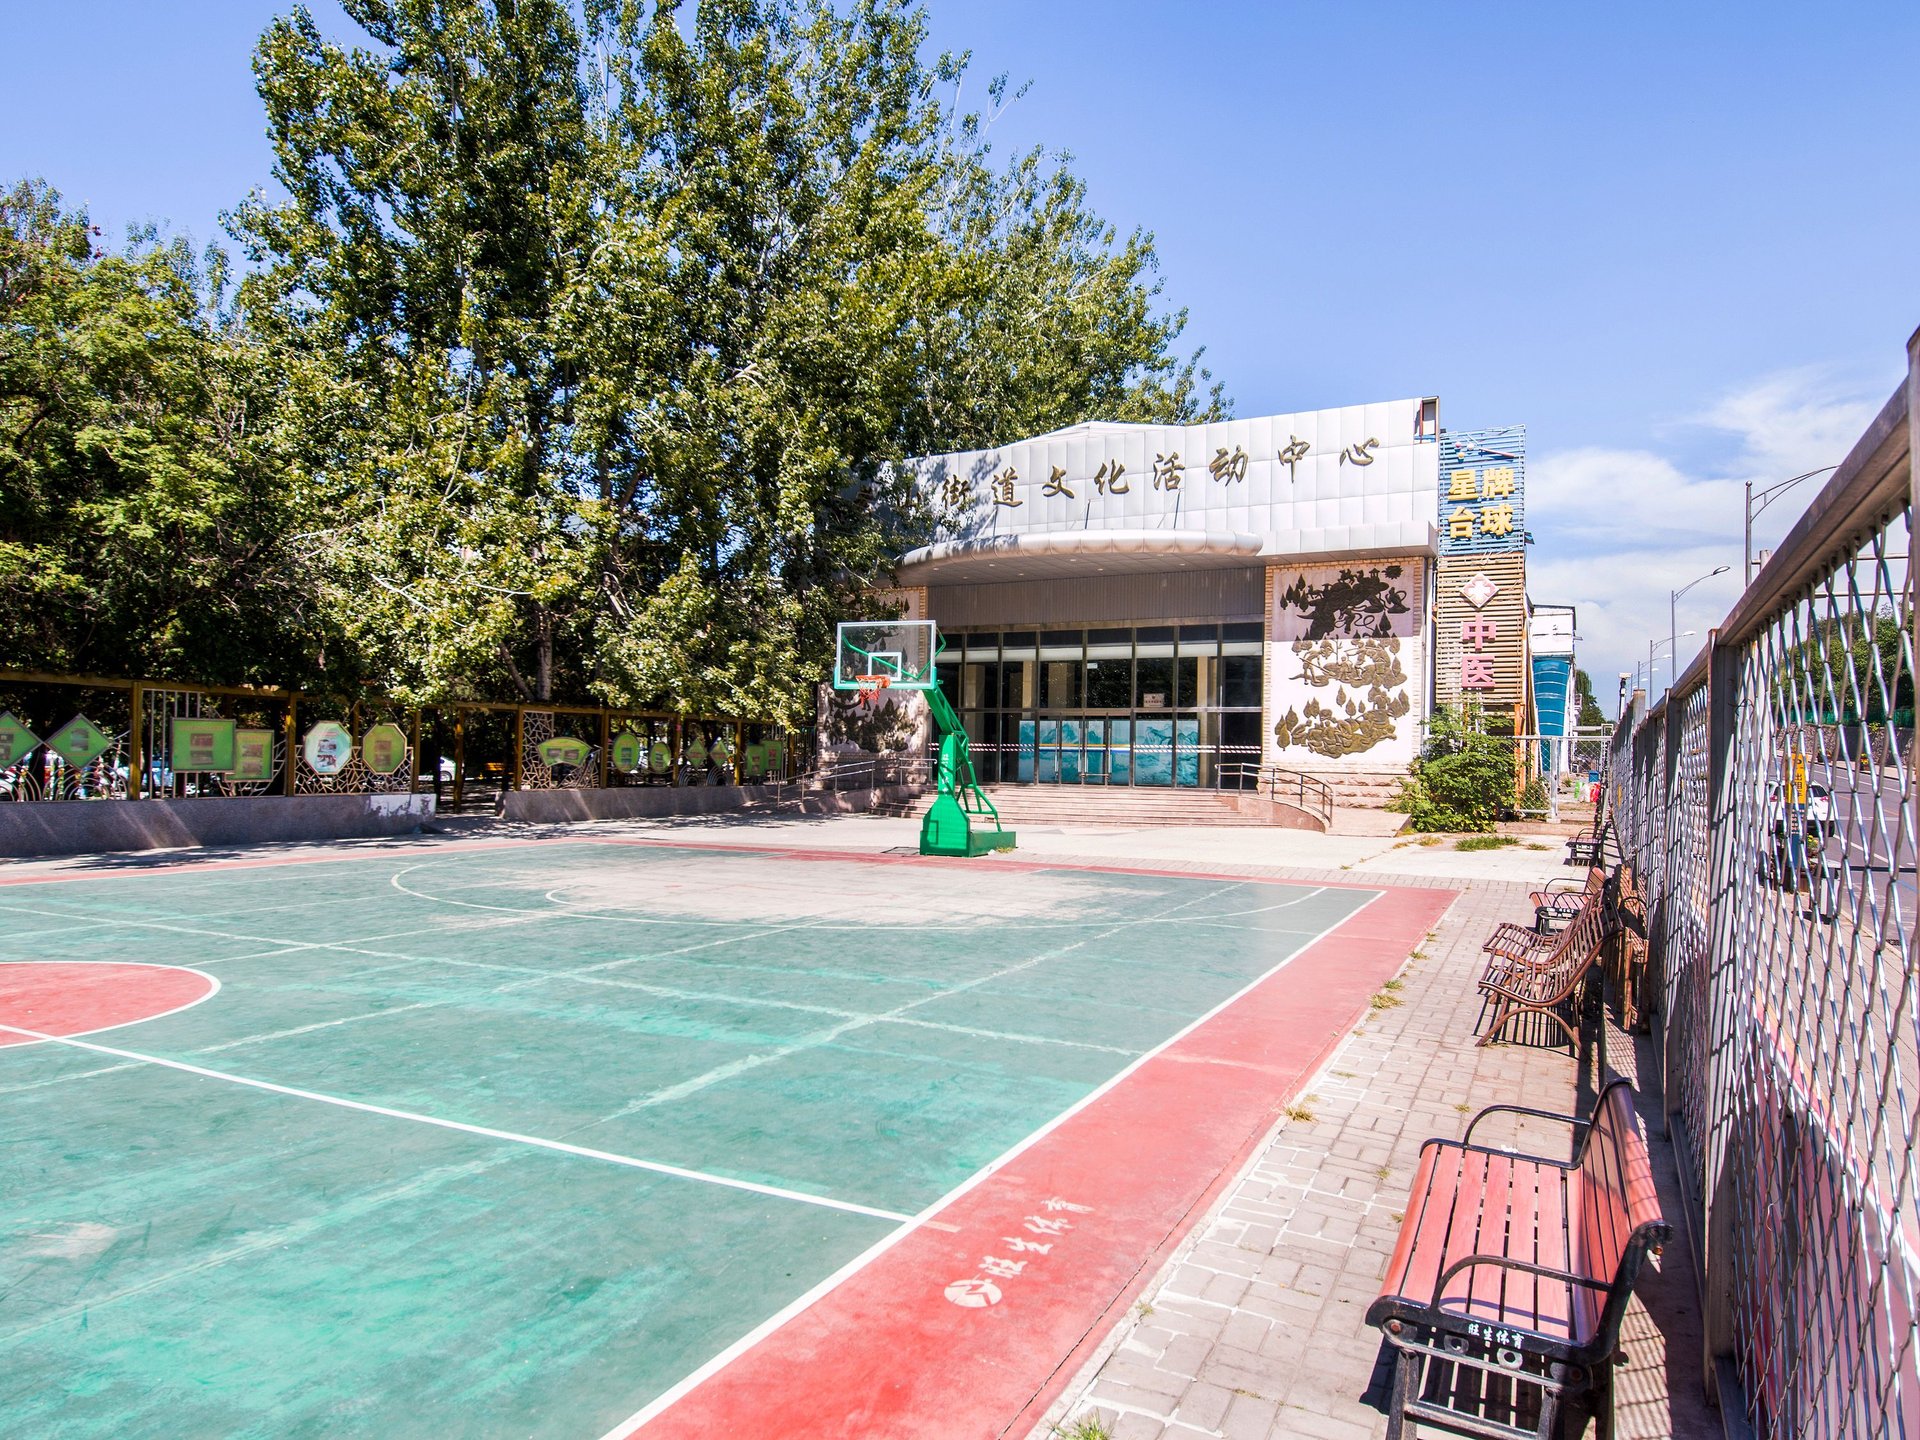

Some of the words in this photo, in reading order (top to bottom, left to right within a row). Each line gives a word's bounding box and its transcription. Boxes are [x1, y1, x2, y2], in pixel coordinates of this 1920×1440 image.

[1448, 466, 1516, 500] 星牌
[1448, 503, 1515, 539] 台球
[1461, 613, 1497, 688] 中医
[1468, 1323, 1525, 1349] 旺生体育
